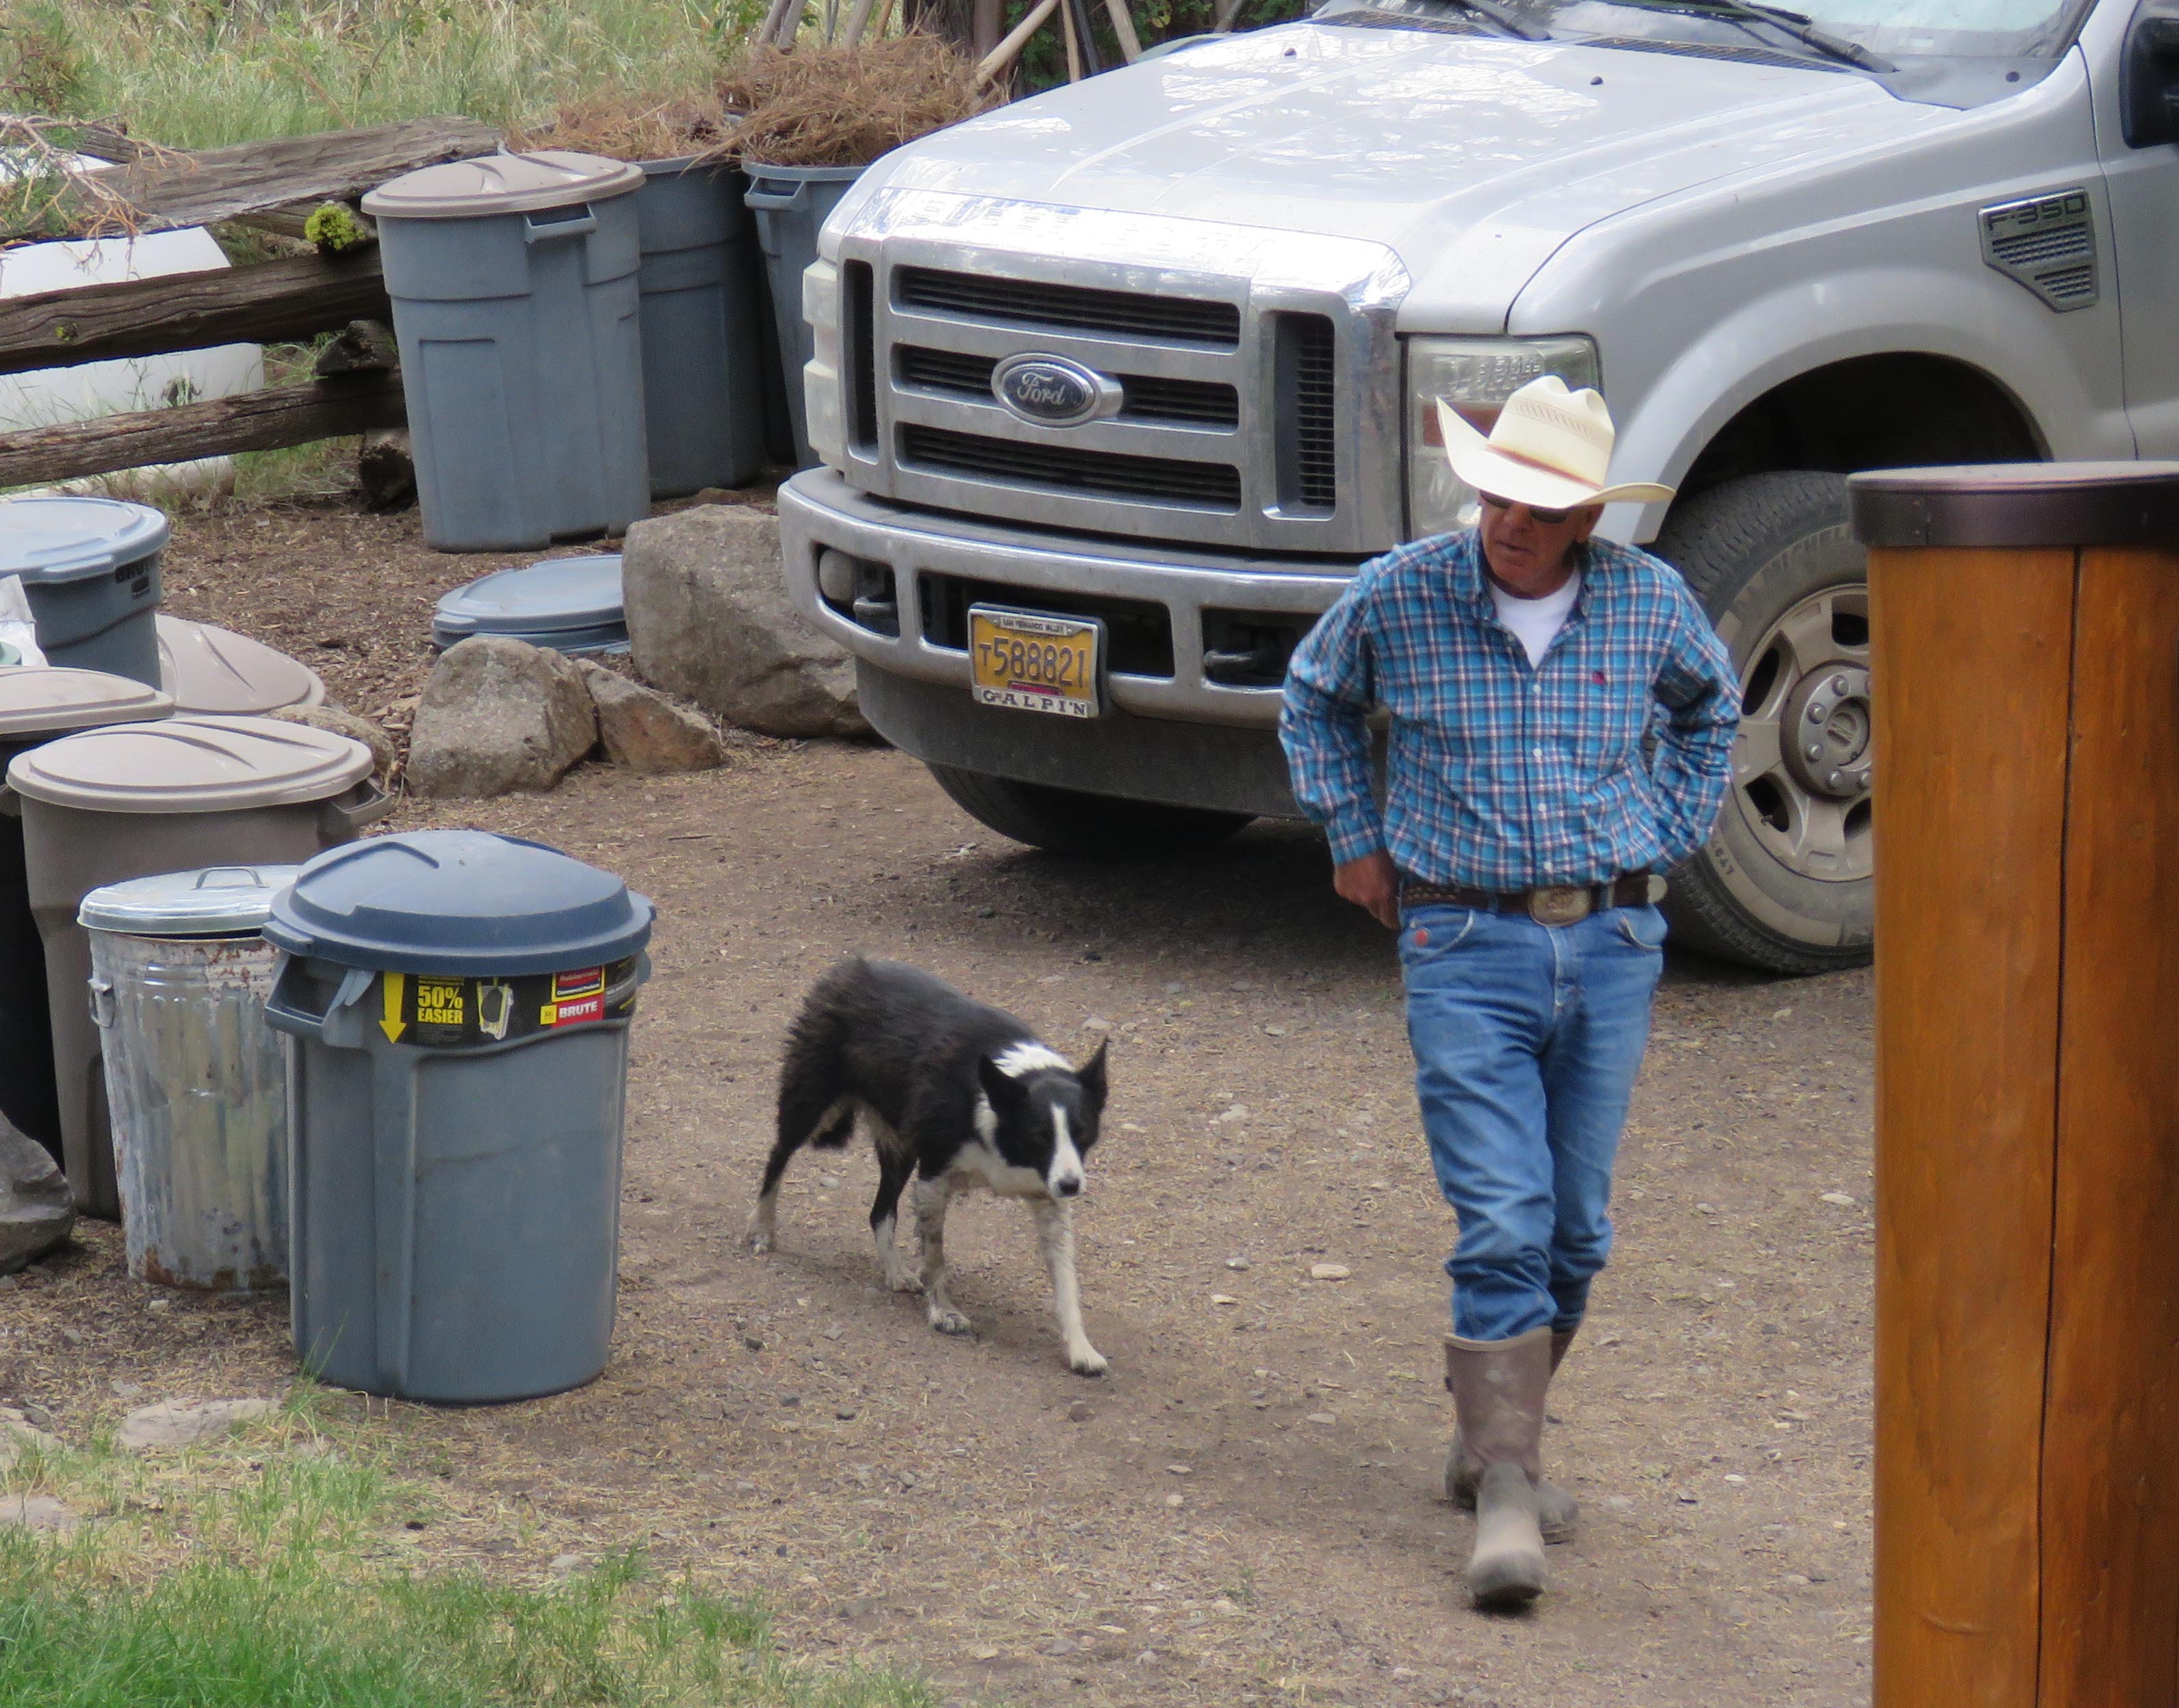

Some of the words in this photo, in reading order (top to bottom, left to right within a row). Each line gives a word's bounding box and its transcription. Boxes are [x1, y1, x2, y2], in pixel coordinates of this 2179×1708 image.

[1987, 193, 2086, 231] F-350
[1017, 372, 1066, 405] Ford
[979, 636, 1085, 688] T588821
[983, 690, 1086, 715] GALPIN
[417, 985, 463, 1009] 50%
[558, 1000, 598, 1019] BRUTE
[417, 1007, 463, 1024] EASIER
